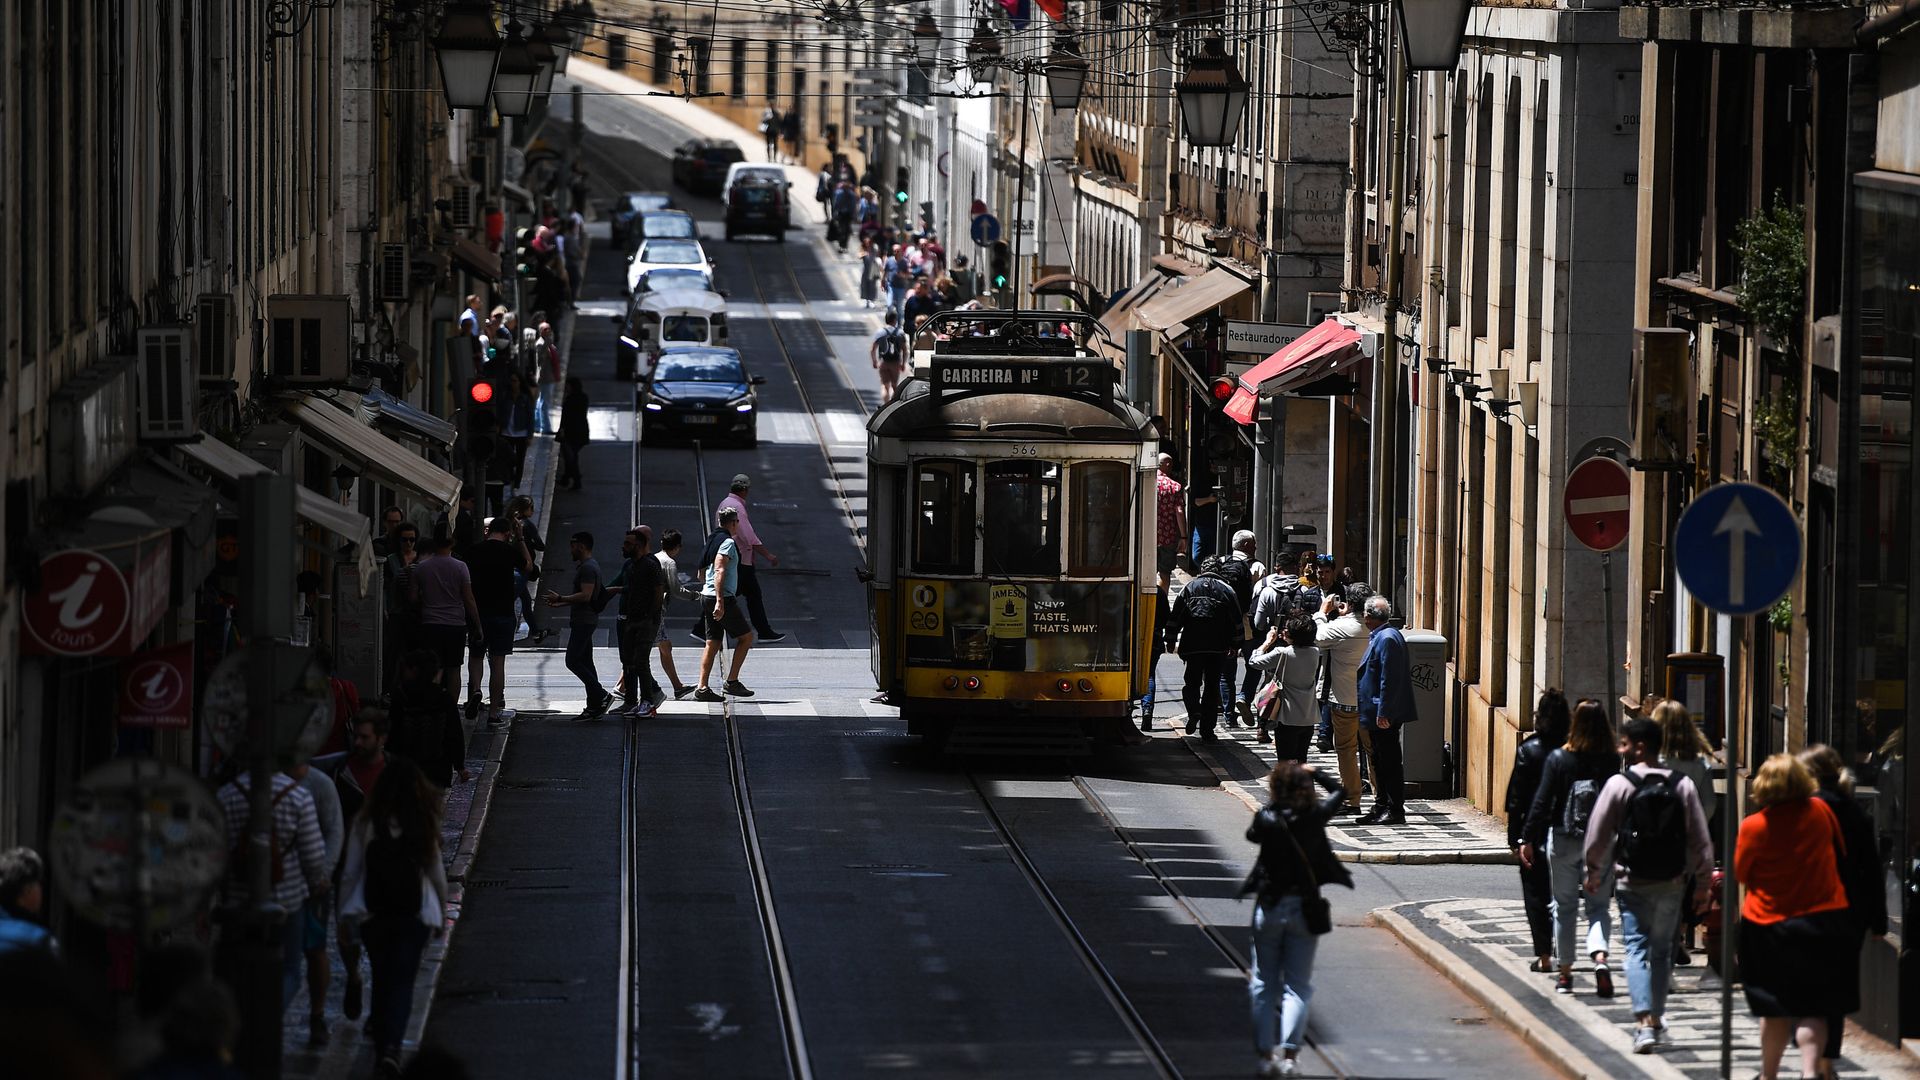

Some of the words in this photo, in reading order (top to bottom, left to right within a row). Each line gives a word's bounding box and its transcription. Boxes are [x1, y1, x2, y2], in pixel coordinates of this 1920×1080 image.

[1228, 329, 1296, 345] Restauradores
[942, 368, 1013, 383] CARREIRA
[1065, 367, 1090, 386] 12
[1012, 444, 1037, 456] 566
[1033, 601, 1065, 610] WHY?
[1033, 612, 1070, 622] TASTE,
[1033, 623, 1070, 633] THAT'S
